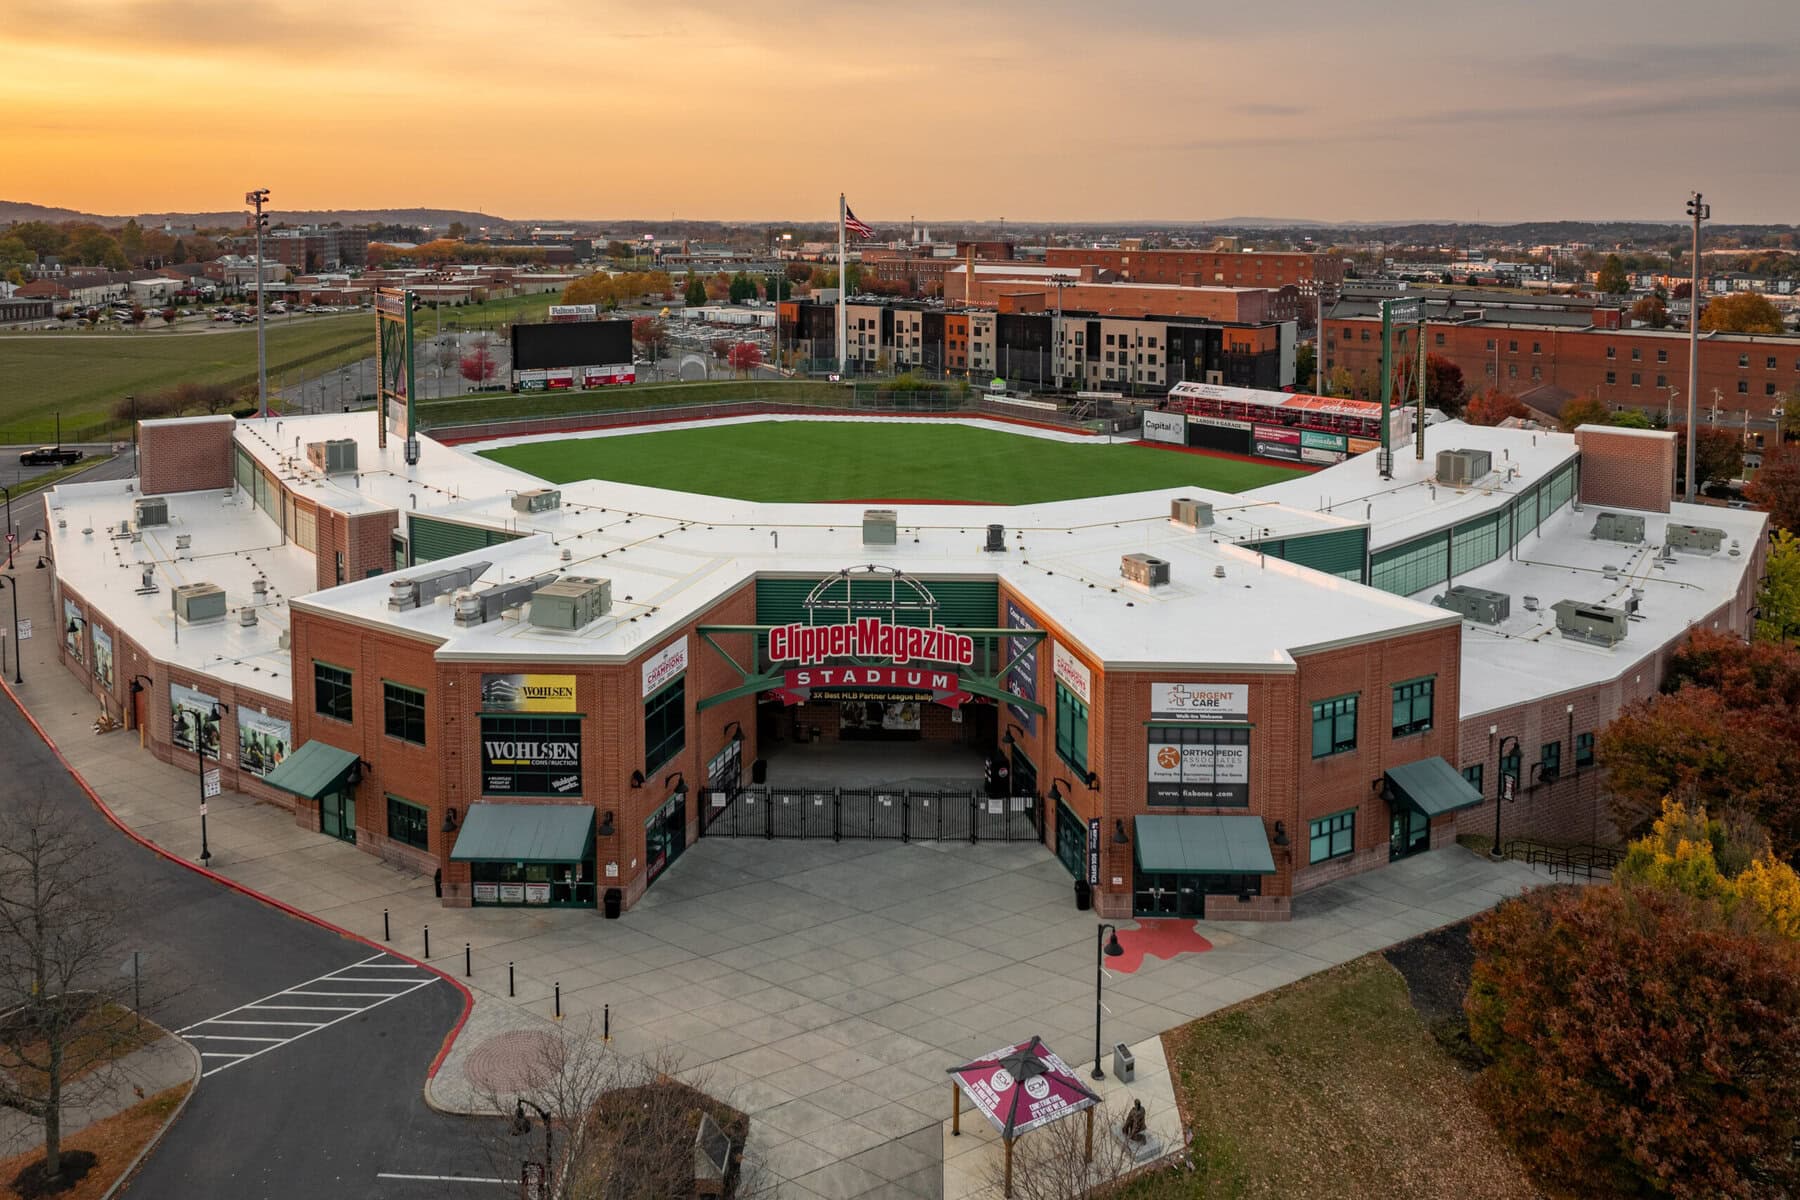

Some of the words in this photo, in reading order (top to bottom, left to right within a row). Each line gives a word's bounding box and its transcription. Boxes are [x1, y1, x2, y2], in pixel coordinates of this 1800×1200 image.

[576, 306, 594, 314] Bank
[1145, 420, 1172, 431] Capital
[647, 654, 684, 684] CHAMPIONS
[797, 670, 948, 689] STADIUM
[523, 687, 573, 696] WOHLSEN
[1192, 692, 1234, 700] URGENT
[859, 692, 886, 700] Partner
[887, 693, 914, 702] League
[485, 741, 579, 760] WOHLSEN
[1182, 749, 1242, 757] ORTHOPEDIC
